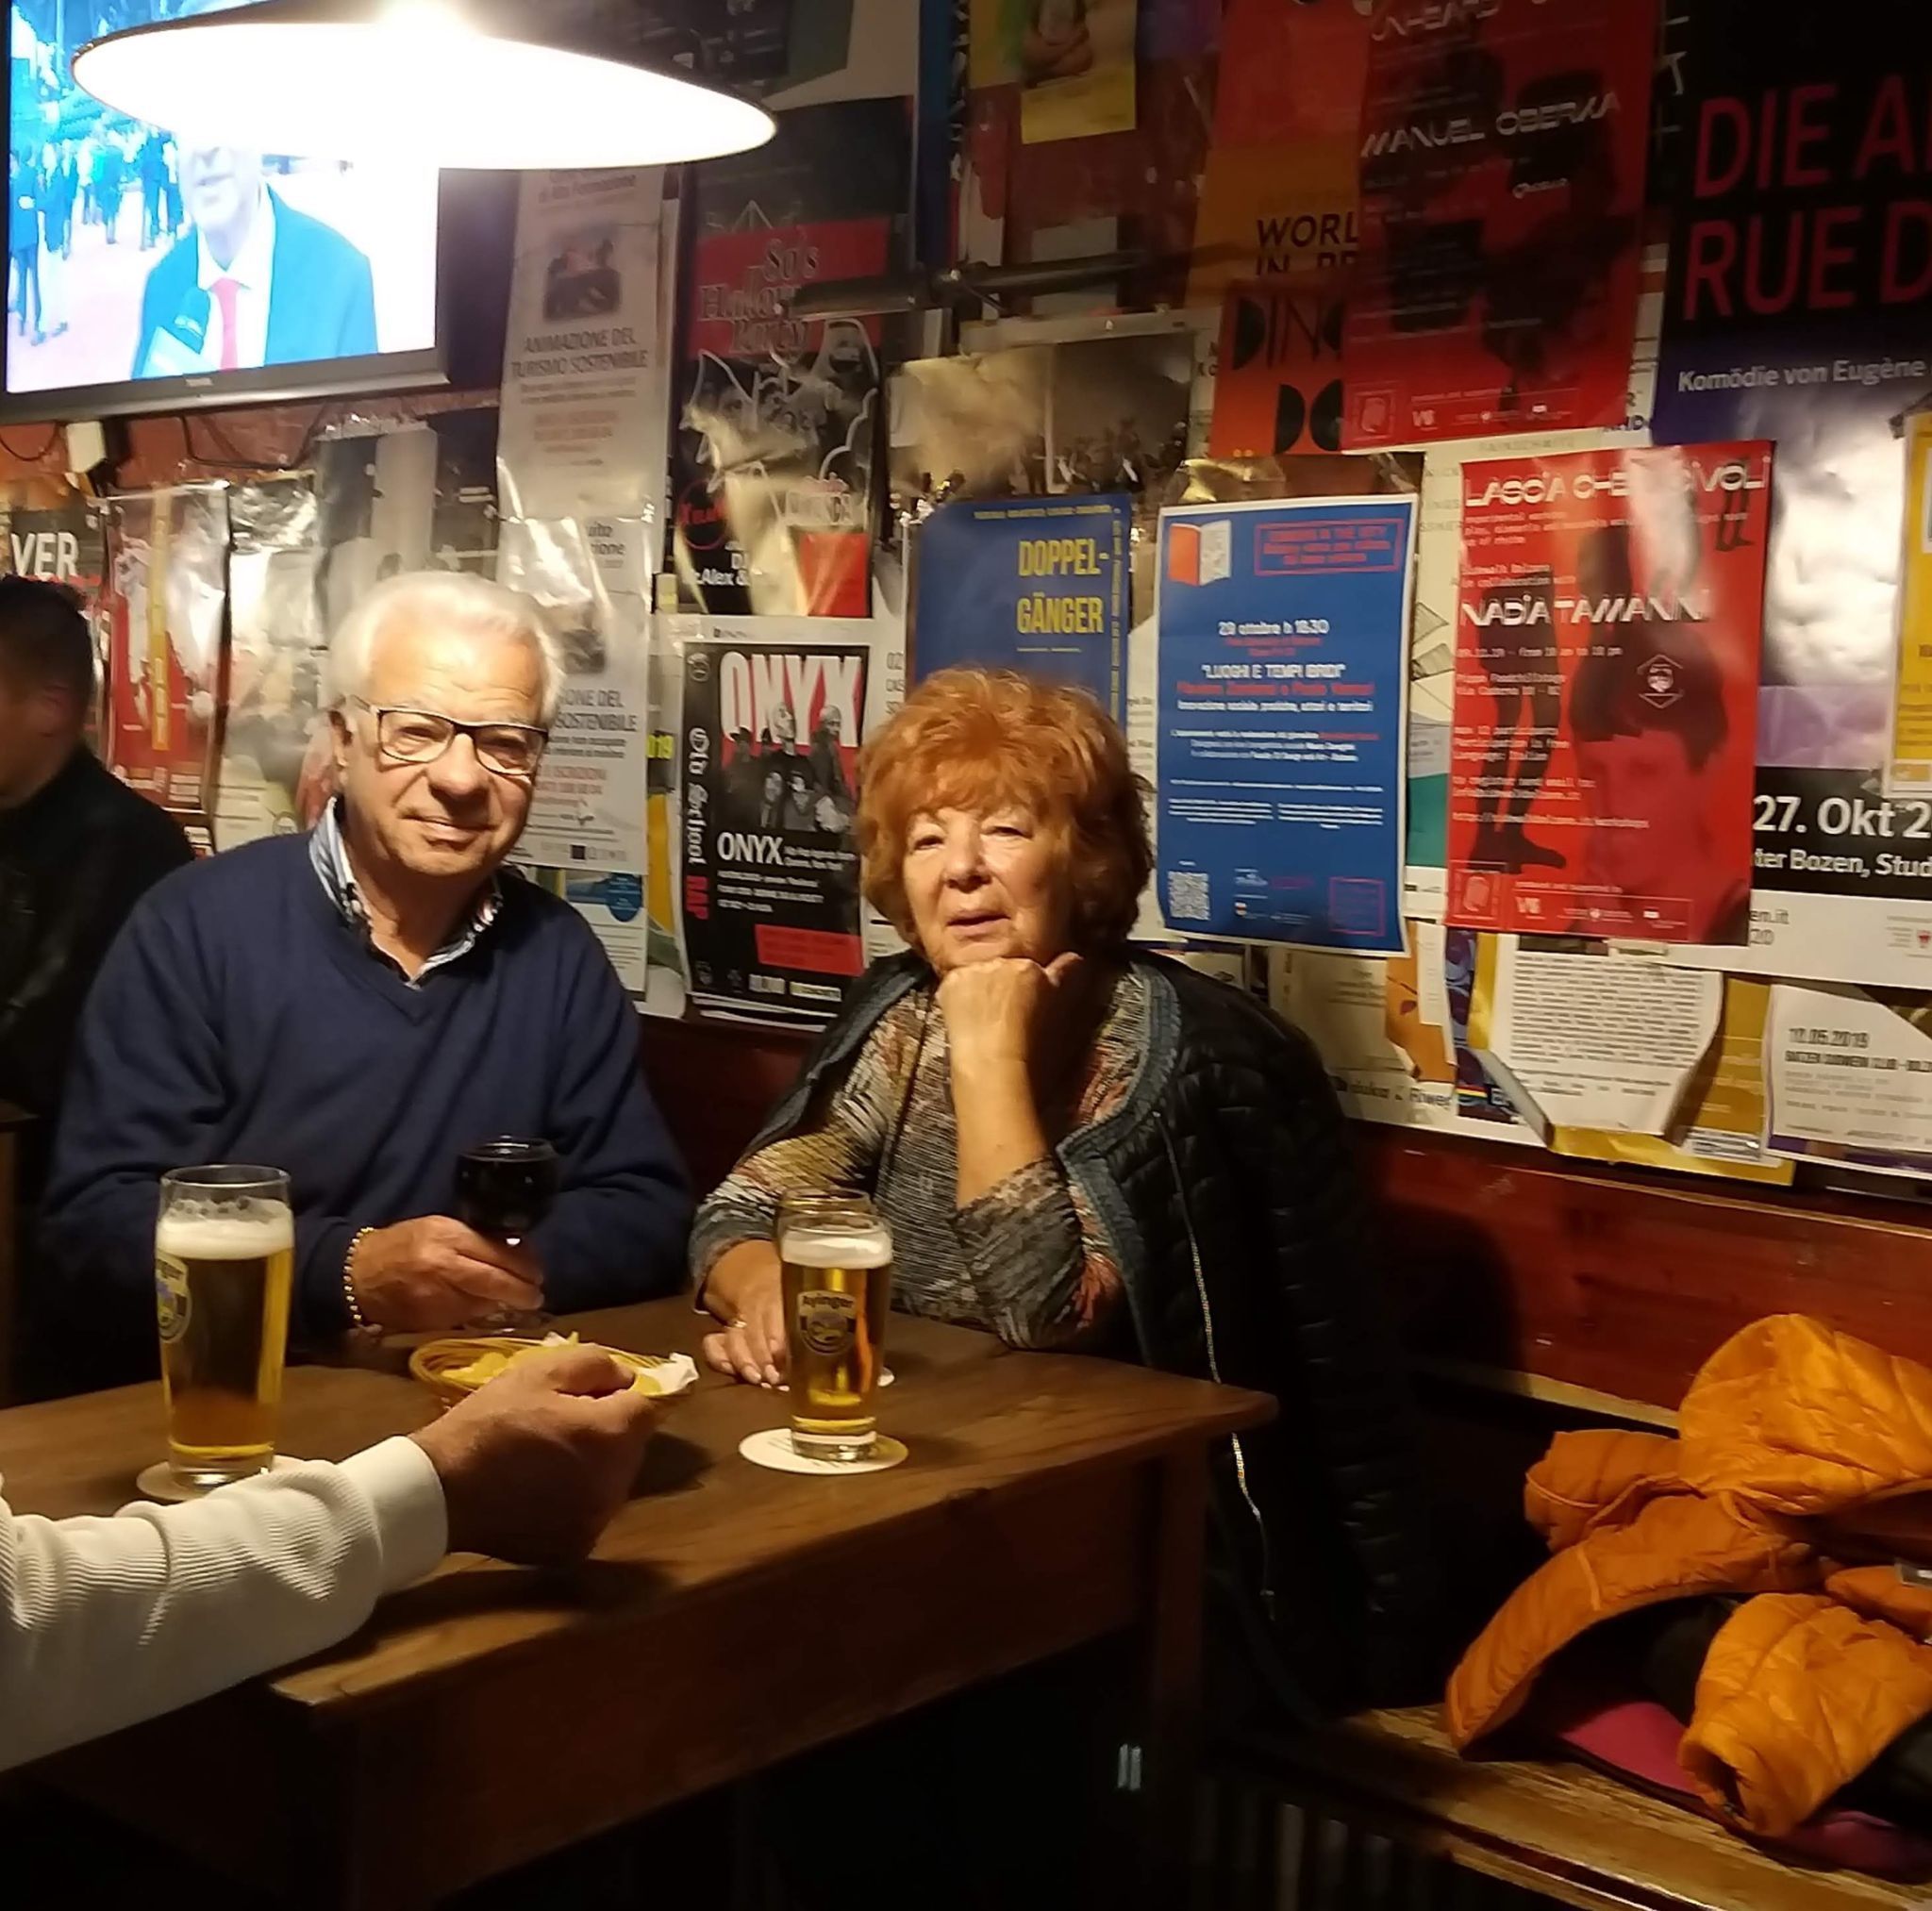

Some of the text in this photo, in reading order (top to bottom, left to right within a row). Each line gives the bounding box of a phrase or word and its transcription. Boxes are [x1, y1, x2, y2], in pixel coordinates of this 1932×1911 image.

[1360, 117, 1486, 158] MANUEL
[1693, 74, 1932, 198] DIE A
[1683, 205, 1863, 321] RUE
[1677, 357, 1926, 392] Komödie von Eugène
[10, 532, 79, 578] VER
[1018, 538, 1110, 577] DOPPEL-
[1016, 591, 1104, 635] GÄNGER
[720, 651, 863, 747] ONYX
[1752, 794, 1807, 833] 27.
[1817, 798, 1896, 838] Okt
[716, 831, 786, 867] ONYX
[1790, 848, 1871, 878] Bozen,
